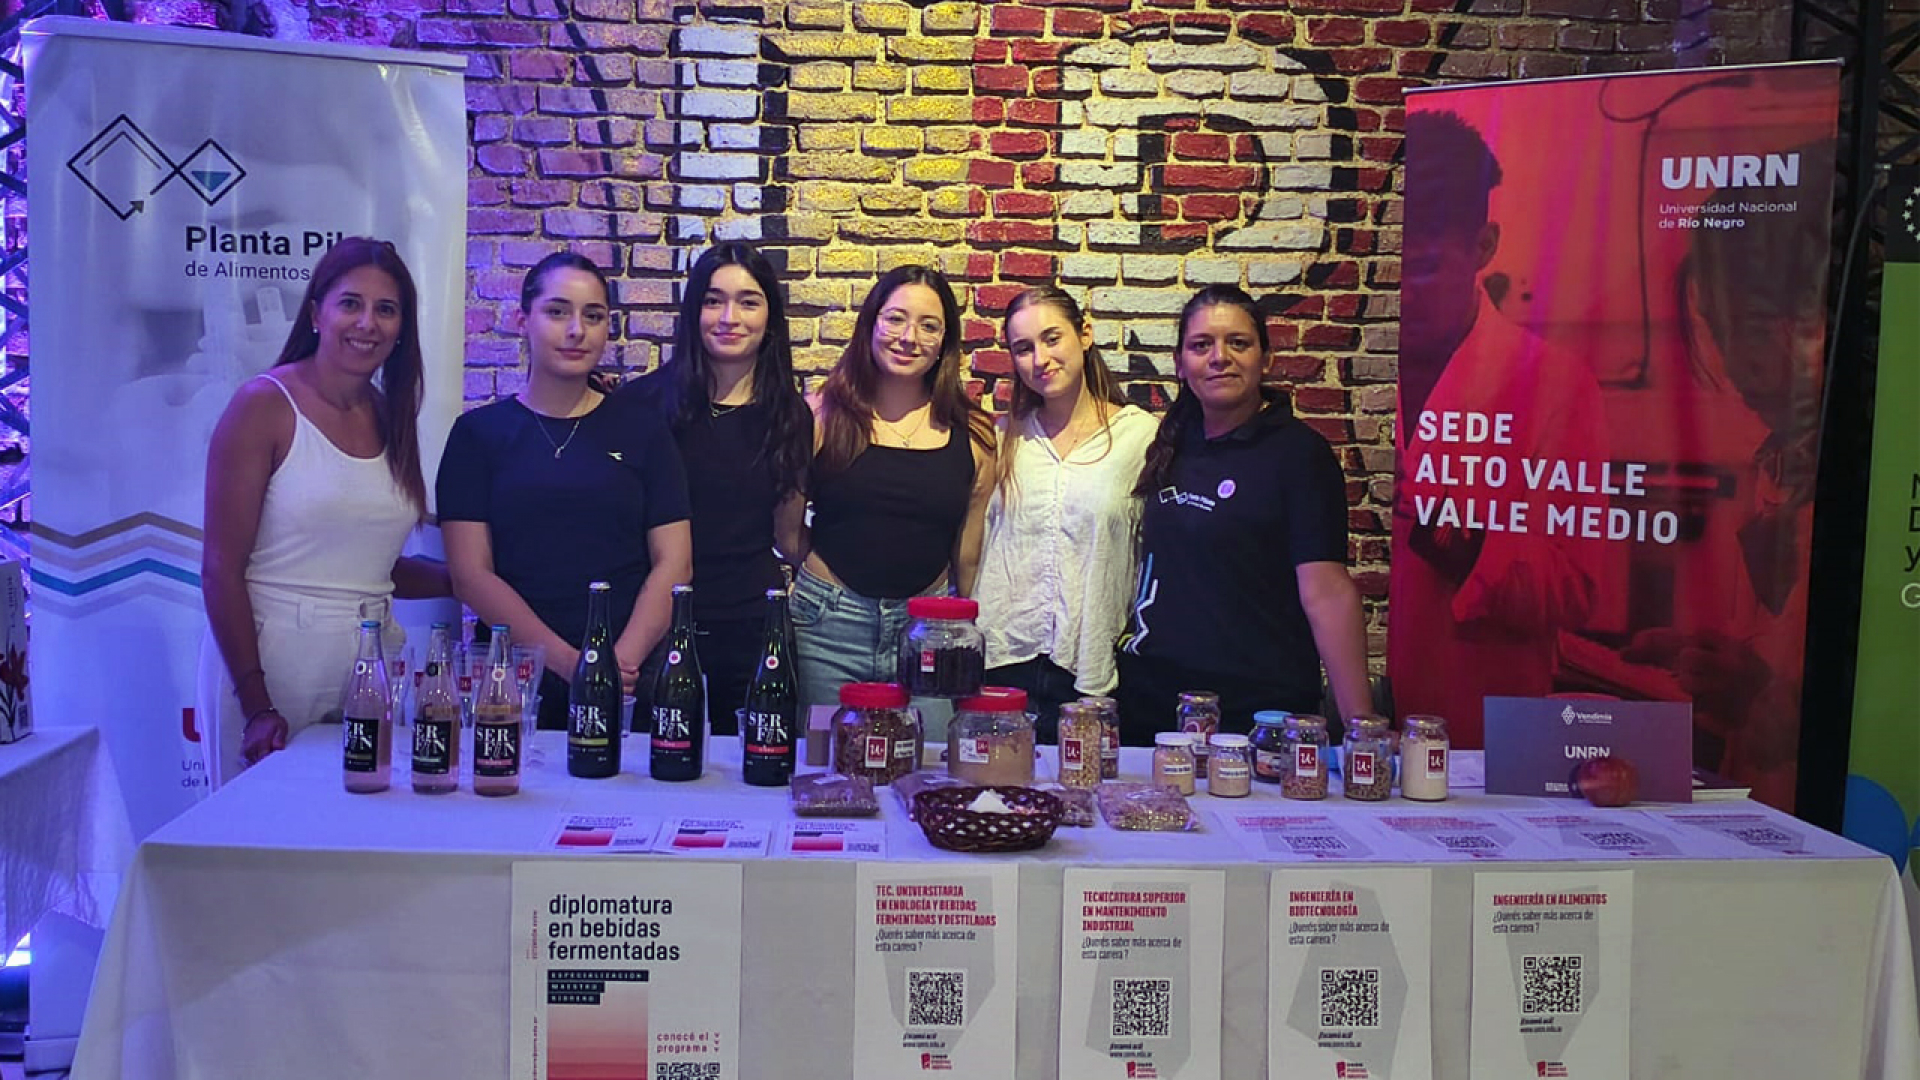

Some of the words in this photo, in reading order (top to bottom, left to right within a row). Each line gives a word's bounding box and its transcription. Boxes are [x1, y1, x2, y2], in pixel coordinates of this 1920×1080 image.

[1662, 153, 1799, 190] UNRN
[1659, 203, 1735, 214] Universidad
[1739, 201, 1797, 212] Nacional
[1659, 218, 1675, 229] de
[1678, 217, 1700, 229] Río
[1704, 217, 1745, 230] Negro
[185, 225, 291, 256] Planta
[185, 260, 208, 277] de
[214, 261, 311, 281] Alimentos
[1418, 410, 1513, 445] SEDE
[1415, 453, 1507, 488] ALTO
[1521, 458, 1648, 496] VALLE
[1414, 495, 1530, 533] VALLE
[1547, 503, 1679, 544] MEDIO
[1564, 745, 1610, 759] UNRN
[876, 885, 895, 896] TEC.
[897, 885, 964, 896] UNIVERSITARIA
[1083, 891, 1141, 903] TECNICATURA
[1143, 891, 1186, 903] SUPERIOR
[1289, 889, 1341, 902] INGENIERÍA
[1343, 890, 1354, 902] EN
[876, 900, 887, 911] EN
[889, 898, 931, 911] ENOLOGÍA
[939, 900, 977, 911] BEBIDAS
[1493, 892, 1544, 906] INGENIERÍA
[1546, 894, 1557, 905] EN
[1558, 894, 1608, 905] ALIMENTOS
[549, 893, 673, 919] diplomatura
[1083, 906, 1092, 917] EN
[1095, 906, 1168, 917] MANTENIMIENTO
[1289, 904, 1358, 917] BIOTECNOLOGÍA
[876, 914, 937, 925] FERMENTADAS
[945, 914, 997, 926] DESTILADAS
[1522, 910, 1542, 921] saber
[1584, 910, 1593, 921] de
[549, 921, 573, 938] en
[580, 917, 661, 938] bebidas
[1083, 920, 1134, 931] INDUSTRIAL
[1318, 921, 1337, 932] saber
[1380, 921, 1389, 932] de
[905, 929, 924, 940] saber
[967, 929, 976, 940] de
[1111, 936, 1130, 947] saber
[1173, 936, 1182, 947] de
[548, 941, 680, 961] fermentadas
[657, 1032, 696, 1042] conocé
[698, 1031, 709, 1042] el
[656, 1044, 708, 1054] programa
